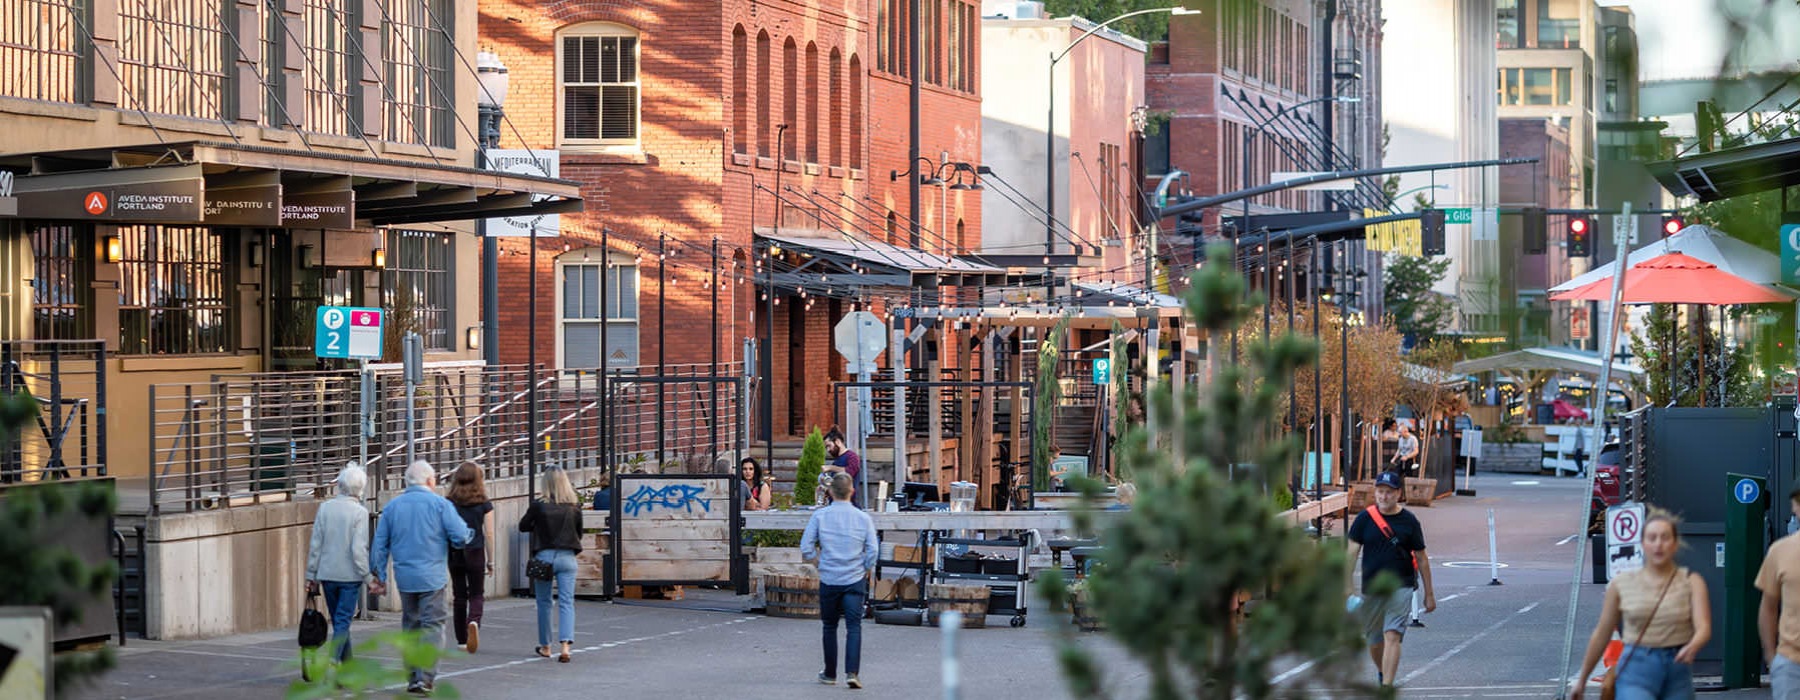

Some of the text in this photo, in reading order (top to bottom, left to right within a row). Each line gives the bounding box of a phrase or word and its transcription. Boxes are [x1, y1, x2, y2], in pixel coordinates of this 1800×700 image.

[149, 195, 193, 204] INSTITUTE
[117, 202, 165, 210] PORTLAND
[203, 200, 273, 209] VDA INSTITUE
[204, 207, 222, 215] ORT
[330, 312, 339, 326] P
[327, 331, 340, 350] 2
[1098, 371, 1106, 380] 2
[1743, 483, 1753, 500] P
